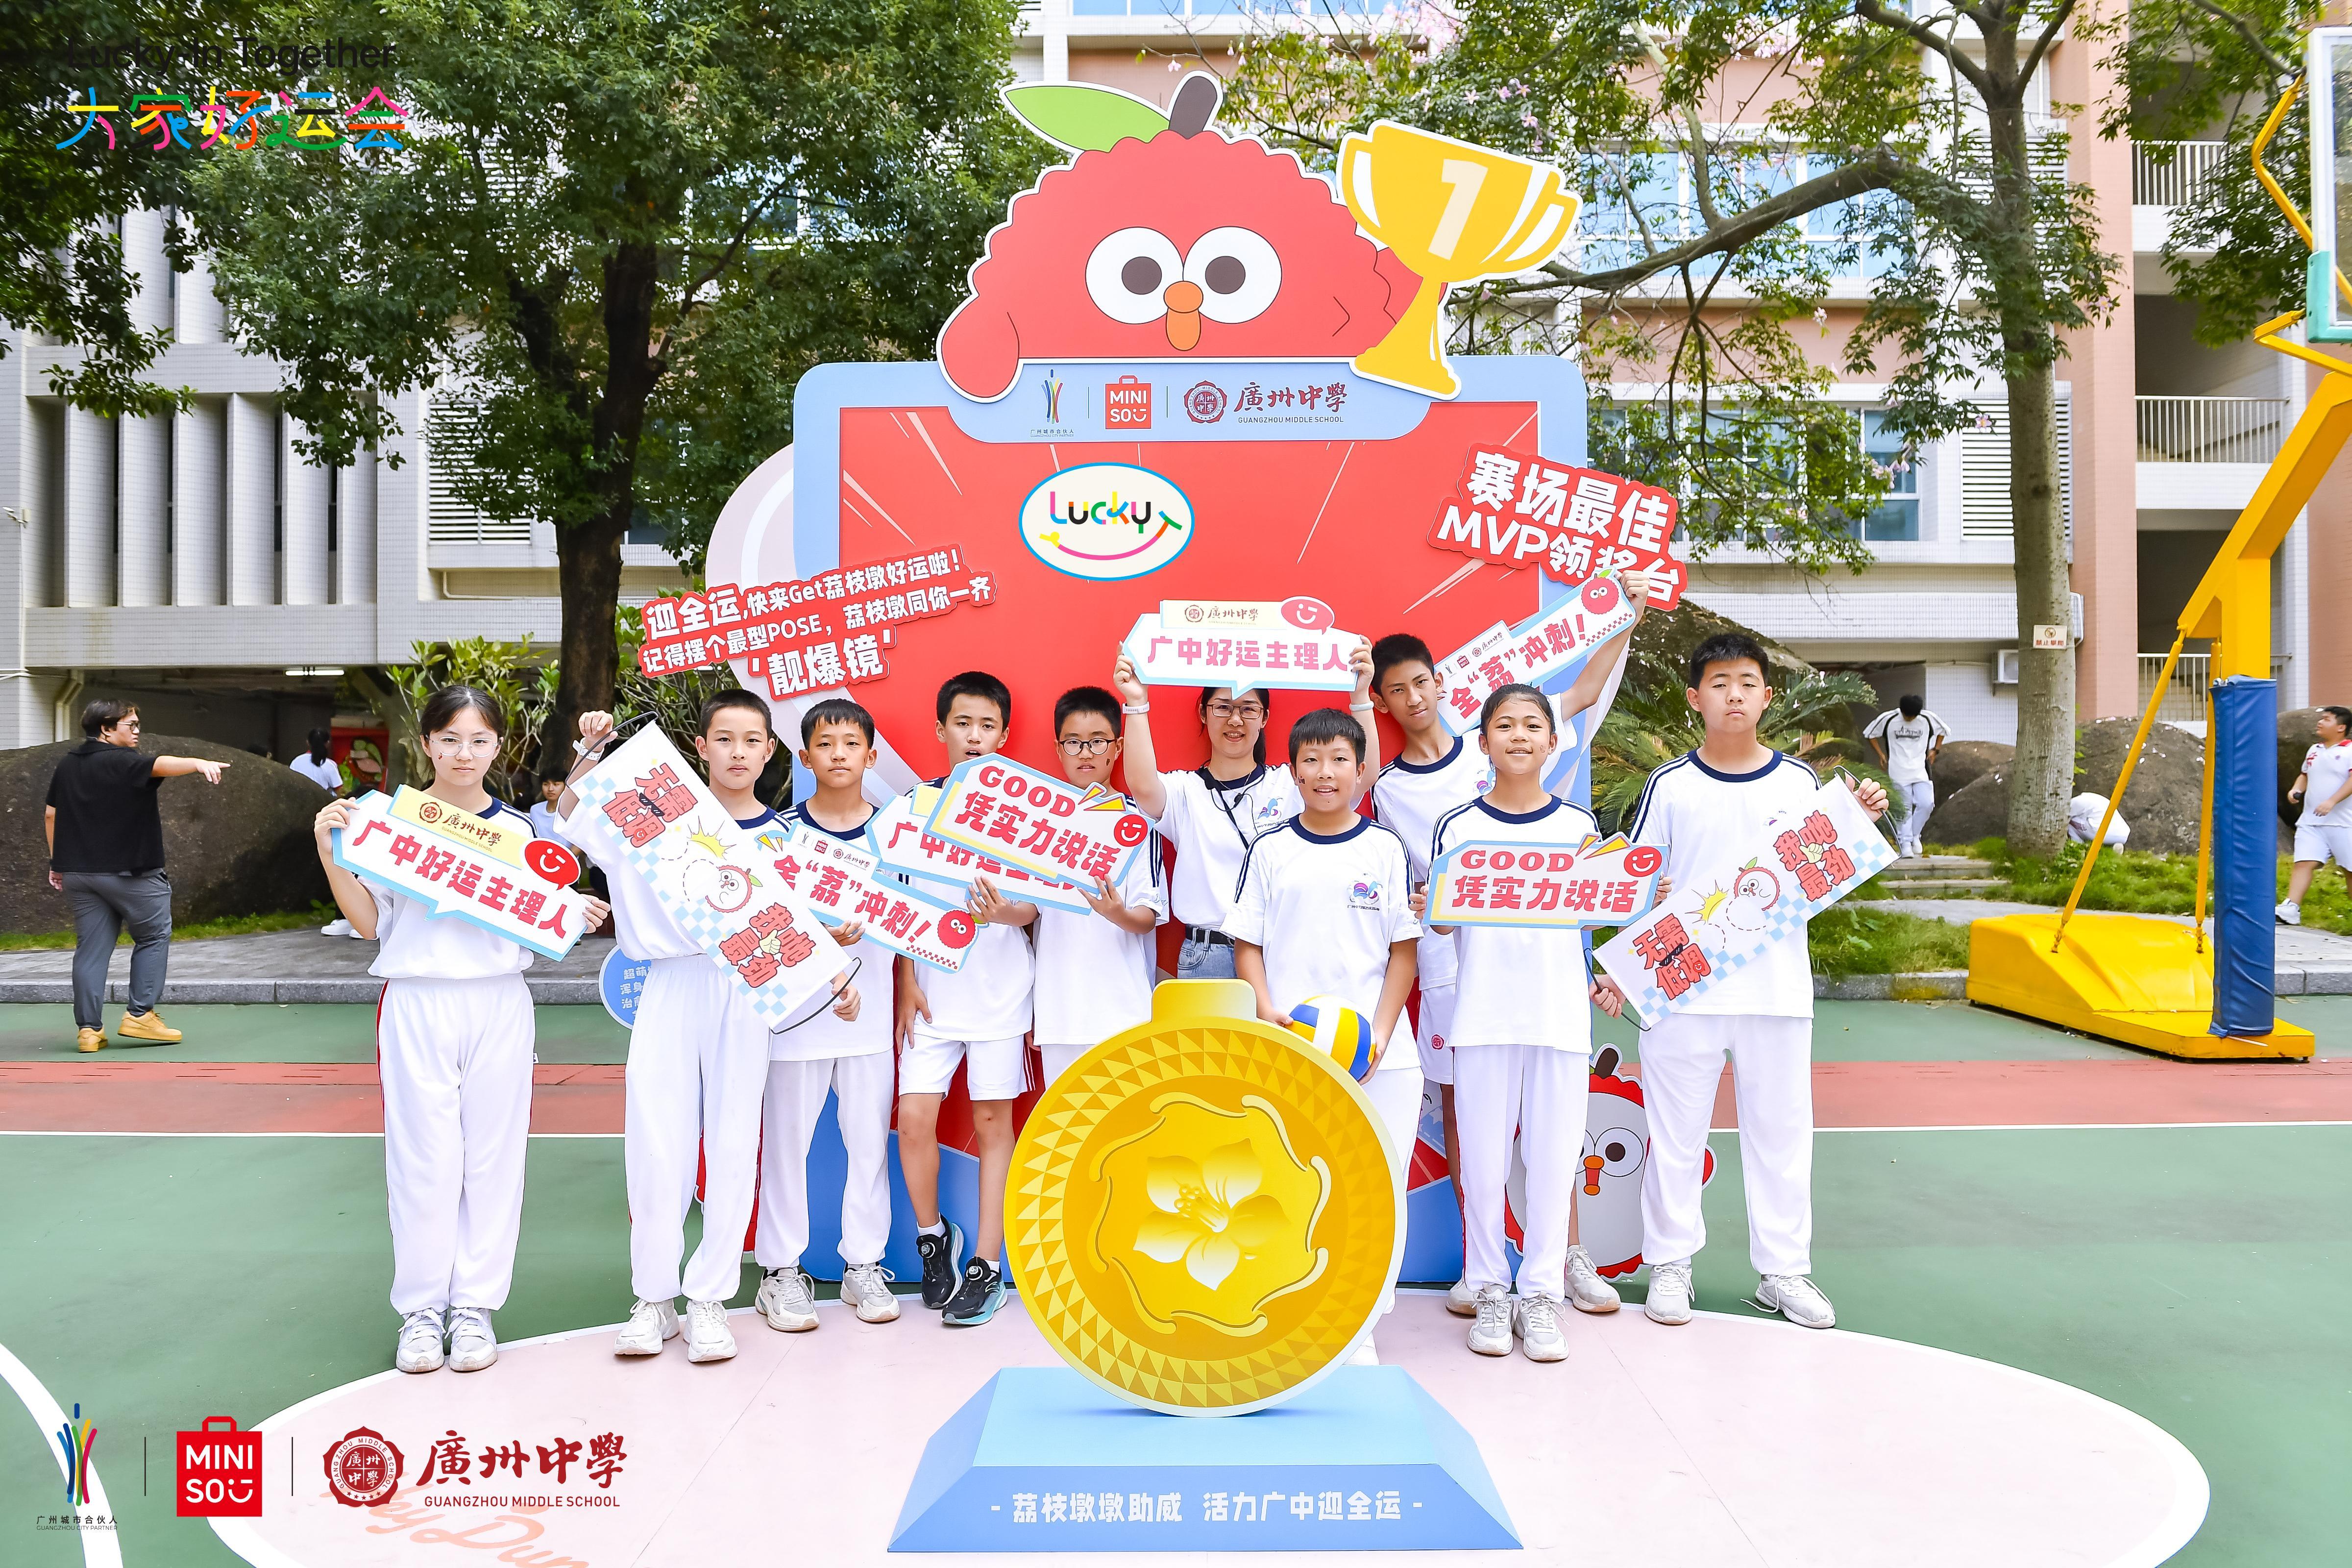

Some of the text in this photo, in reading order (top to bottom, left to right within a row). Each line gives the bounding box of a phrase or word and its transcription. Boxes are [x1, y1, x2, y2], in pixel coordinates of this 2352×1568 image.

[1427, 158, 1489, 261] 1
[1110, 390, 1147, 404] MINI
[1050, 491, 1151, 534] Lucky
[1466, 451, 1670, 554] 赛场最佳
[1437, 505, 1680, 603] MVP领奖台
[1147, 636, 1348, 671] 广中好运主理人
[979, 765, 1076, 817] GOOD
[955, 790, 1121, 880] 凭实力说话
[1461, 850, 1574, 872] GOOD
[352, 819, 567, 939] 广中好运主理人
[1452, 875, 1639, 912] 凭实力说话
[1796, 846, 1856, 902] 最劲
[719, 928, 778, 988] 最劲
[1632, 912, 1690, 970] 无需
[623, 966, 651, 980] 超萌
[1655, 943, 1711, 1000] 低调
[1012, 1490, 1402, 1524] 荔枝墩墩助威 活力广中迎全运
